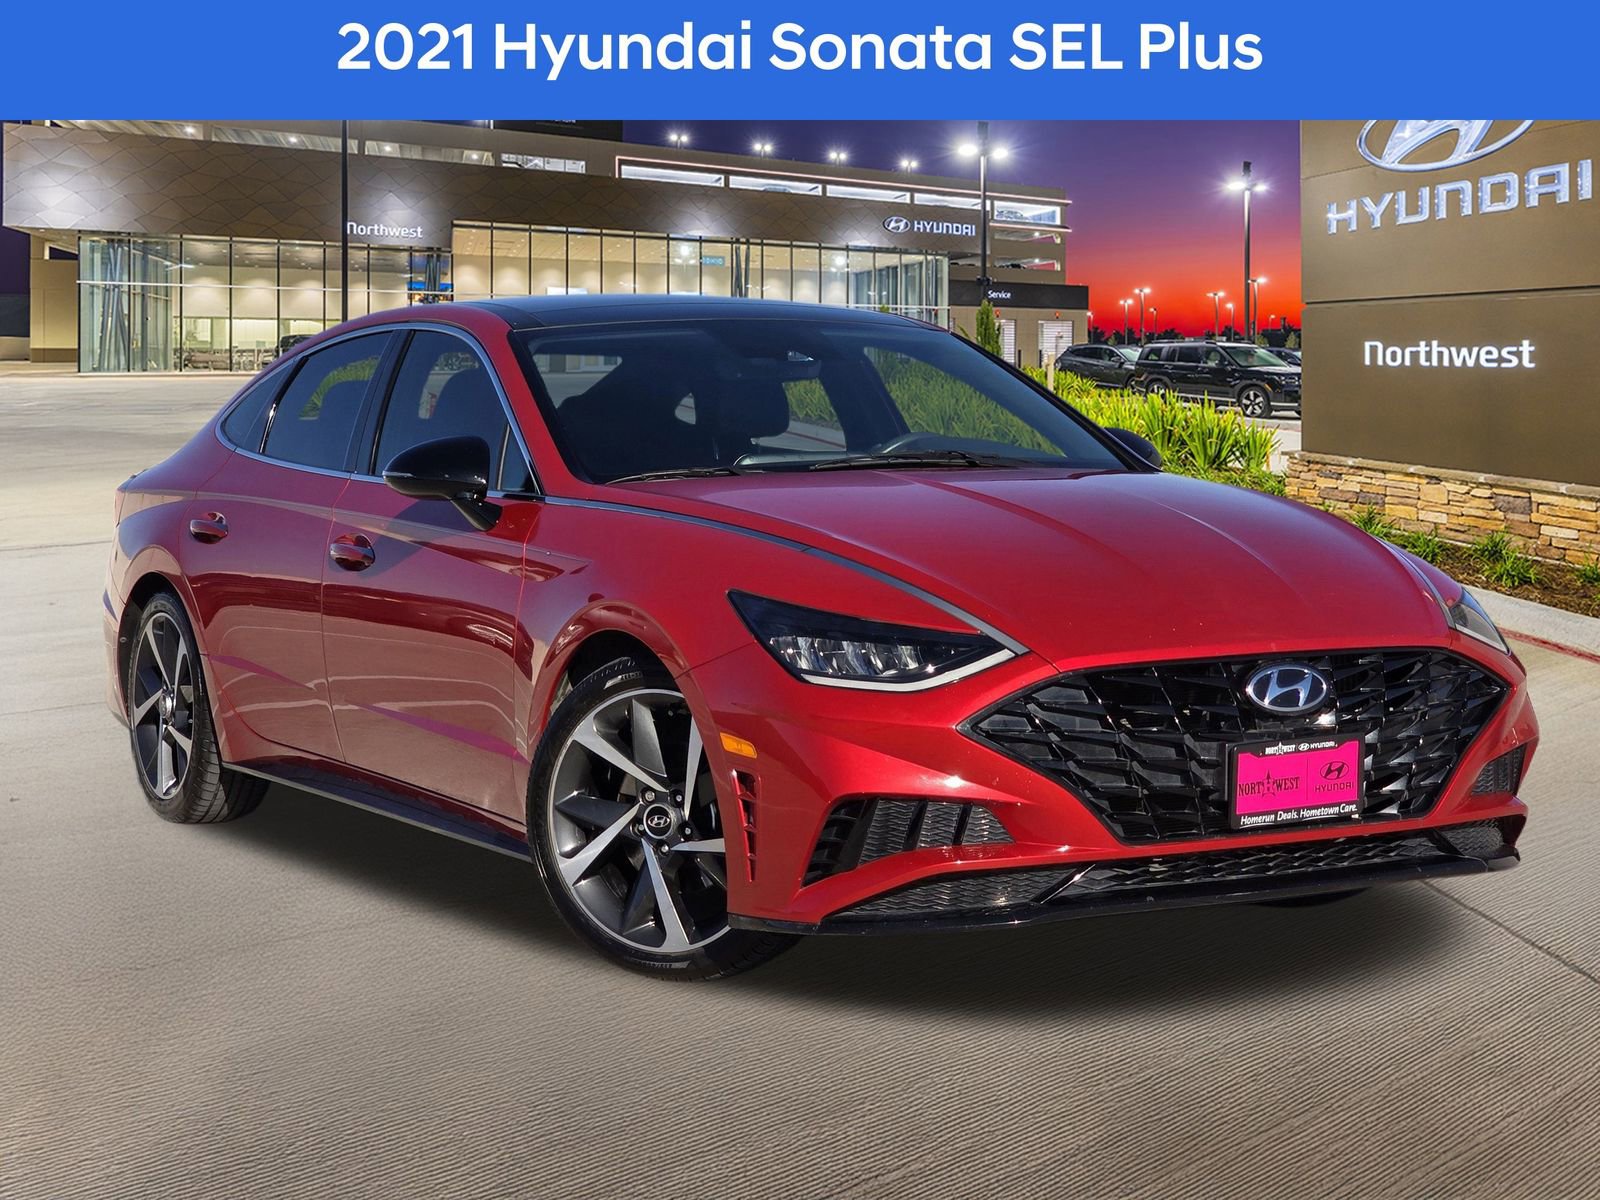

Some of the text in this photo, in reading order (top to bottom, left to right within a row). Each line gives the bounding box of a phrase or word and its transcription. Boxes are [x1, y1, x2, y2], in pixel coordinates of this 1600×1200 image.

[1327, 159, 1593, 235] HYUNDAI
[347, 221, 423, 239] Northwest
[914, 221, 976, 236] HYUNDAI
[987, 290, 1011, 299] Service
[1363, 340, 1536, 369] Northwest
[1315, 781, 1354, 793] HYUNDAI
[1240, 803, 1358, 825] Homerun Deals. Hometown Care.
